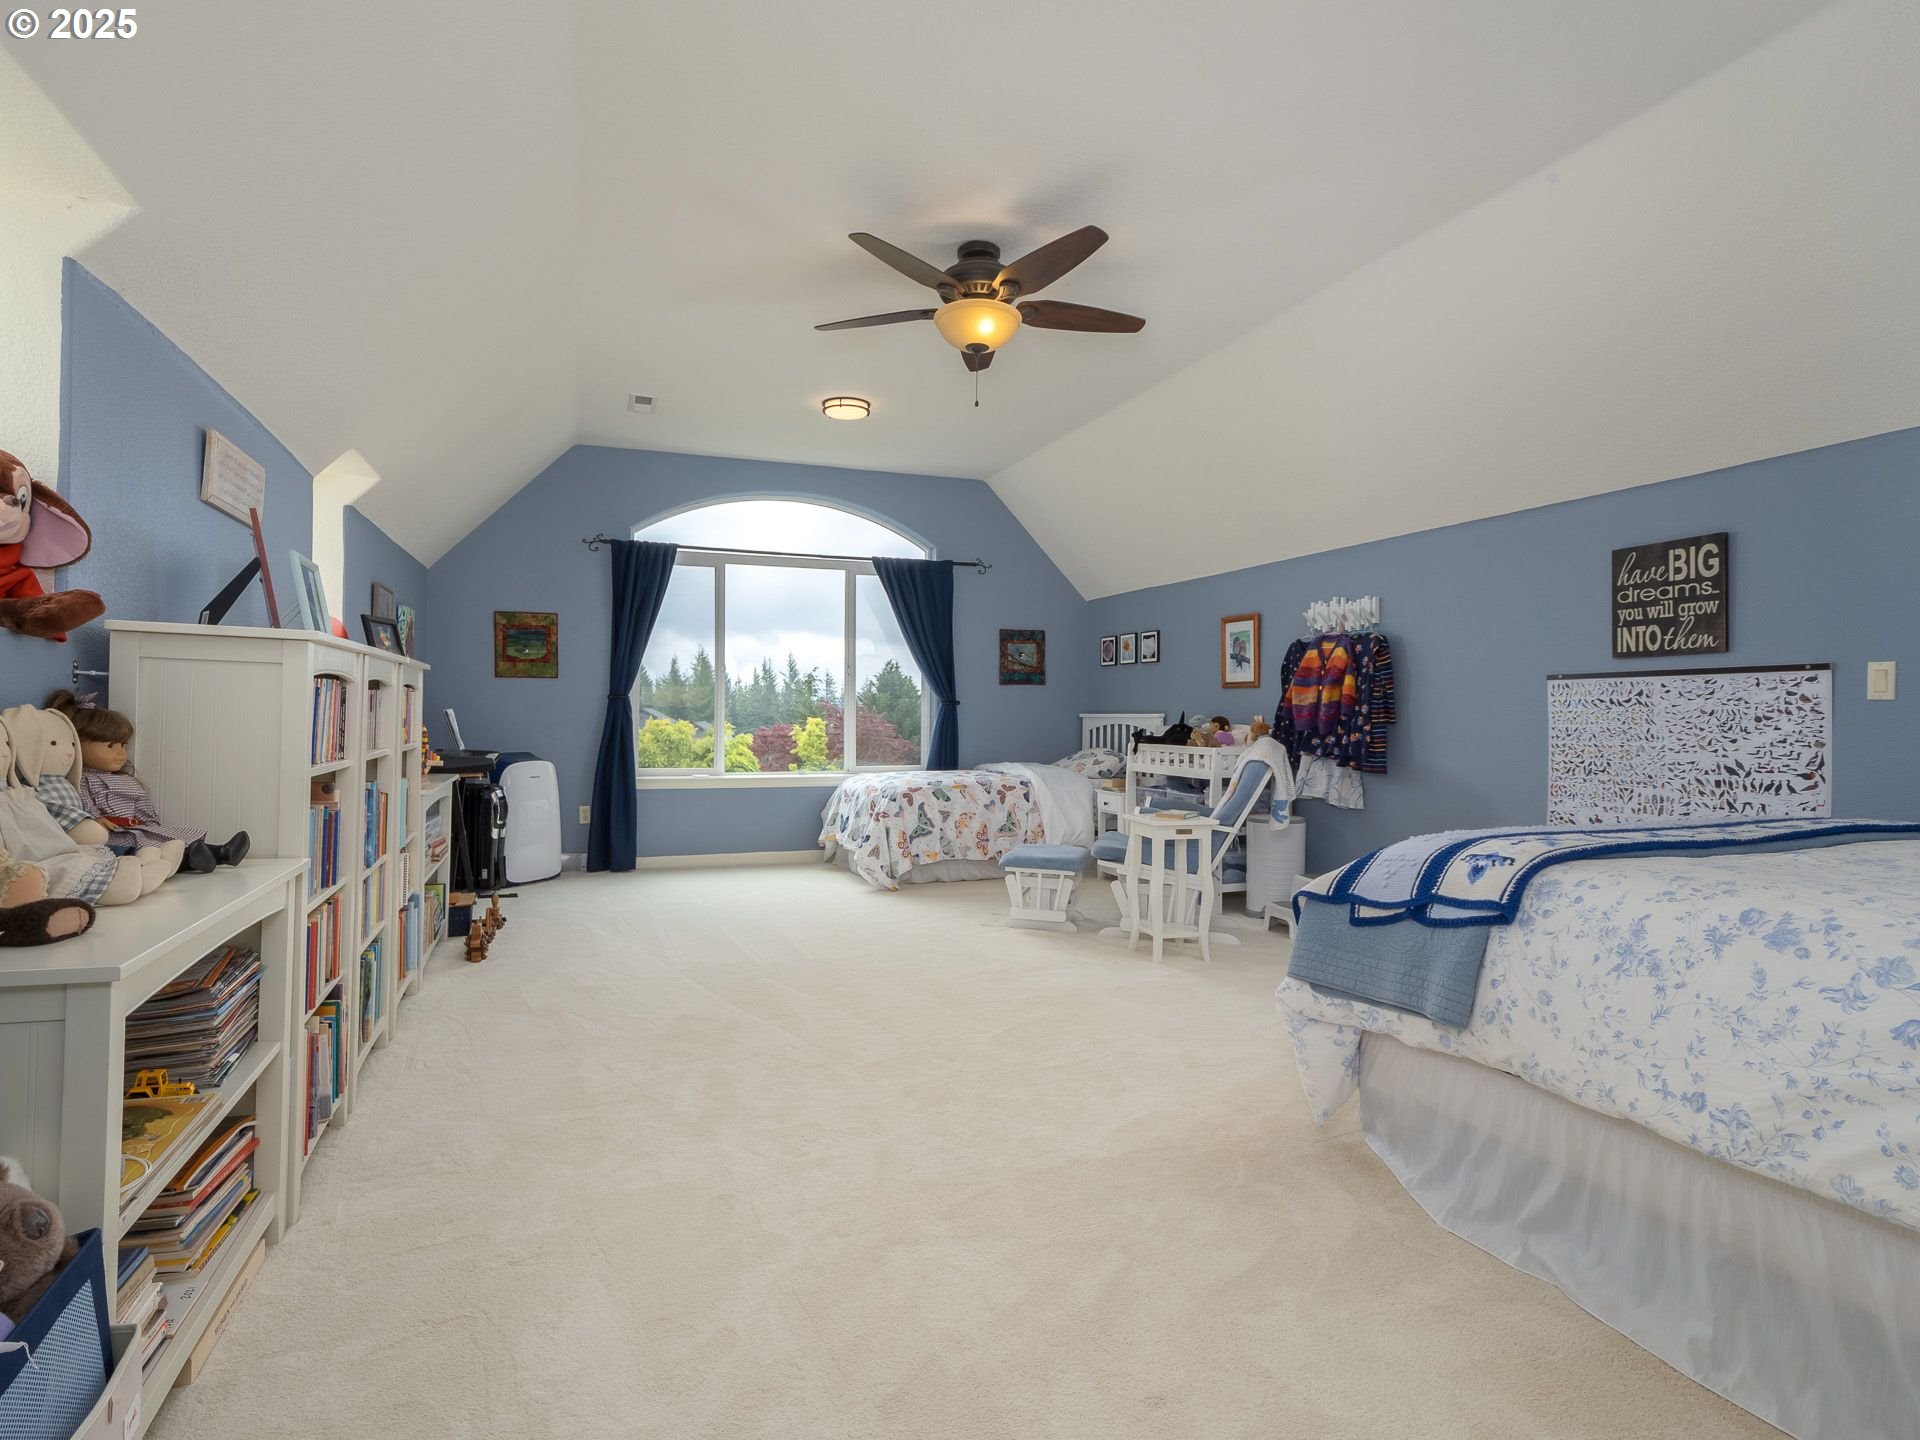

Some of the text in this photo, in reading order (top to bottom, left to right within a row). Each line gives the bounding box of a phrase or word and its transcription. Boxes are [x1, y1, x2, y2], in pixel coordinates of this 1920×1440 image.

[1617, 543, 1720, 586] have BIG
[1617, 600, 1720, 626] you will grow
[1617, 616, 1719, 653] INTO them
